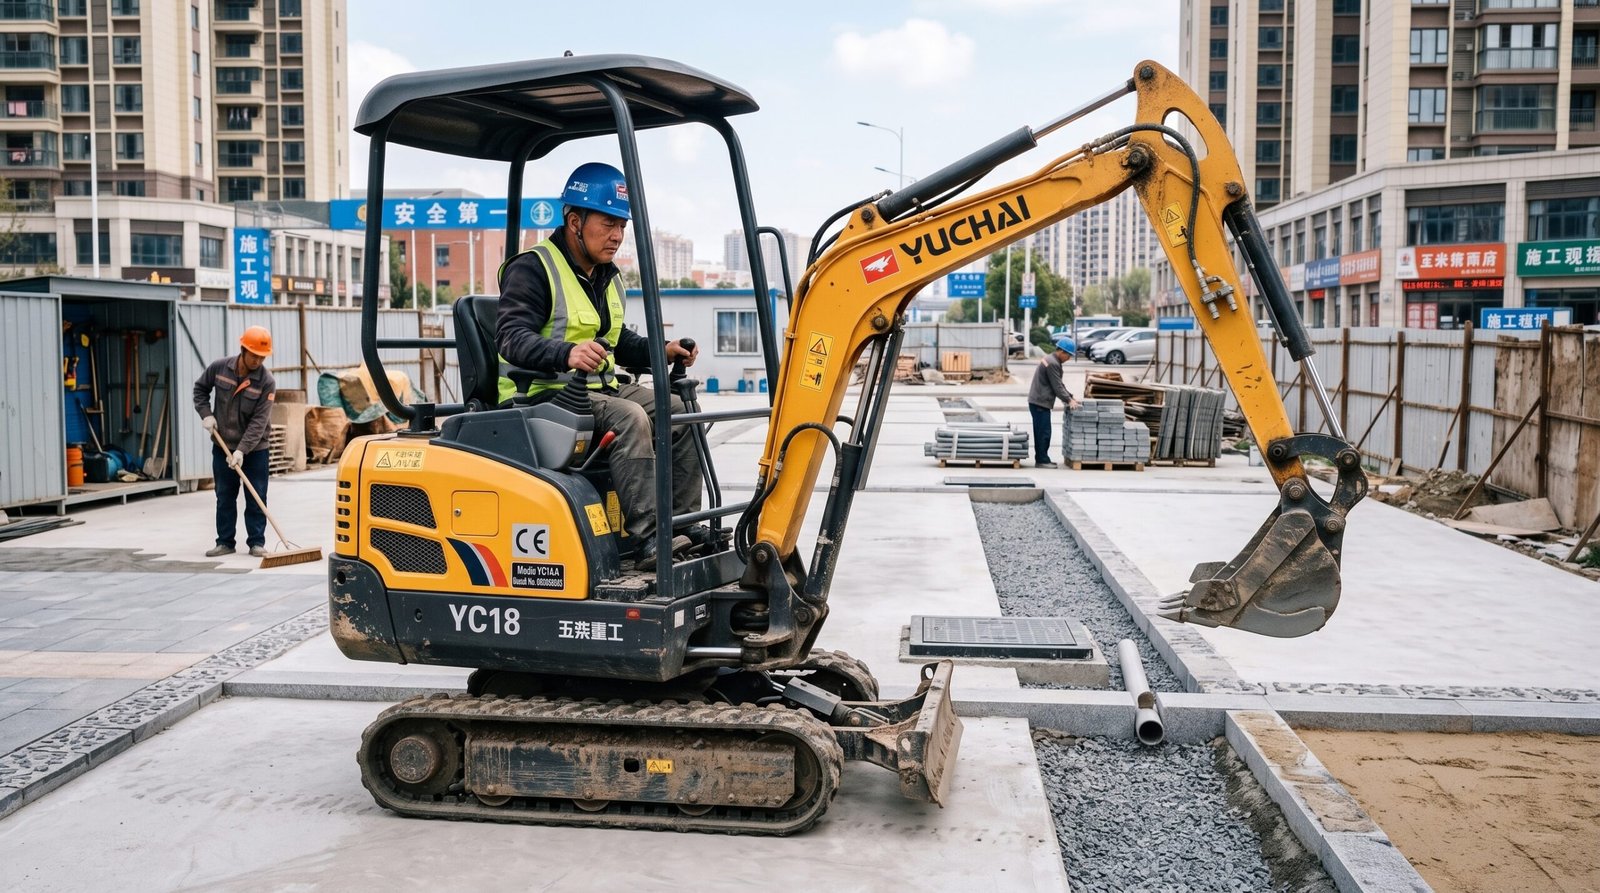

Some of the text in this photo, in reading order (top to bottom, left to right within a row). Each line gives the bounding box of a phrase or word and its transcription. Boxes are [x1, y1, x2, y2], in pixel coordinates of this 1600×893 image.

[395, 201, 507, 225] 安全第一
[899, 194, 1031, 264] YUCHAI
[515, 528, 546, 554] CE
[449, 604, 521, 636] YC18
